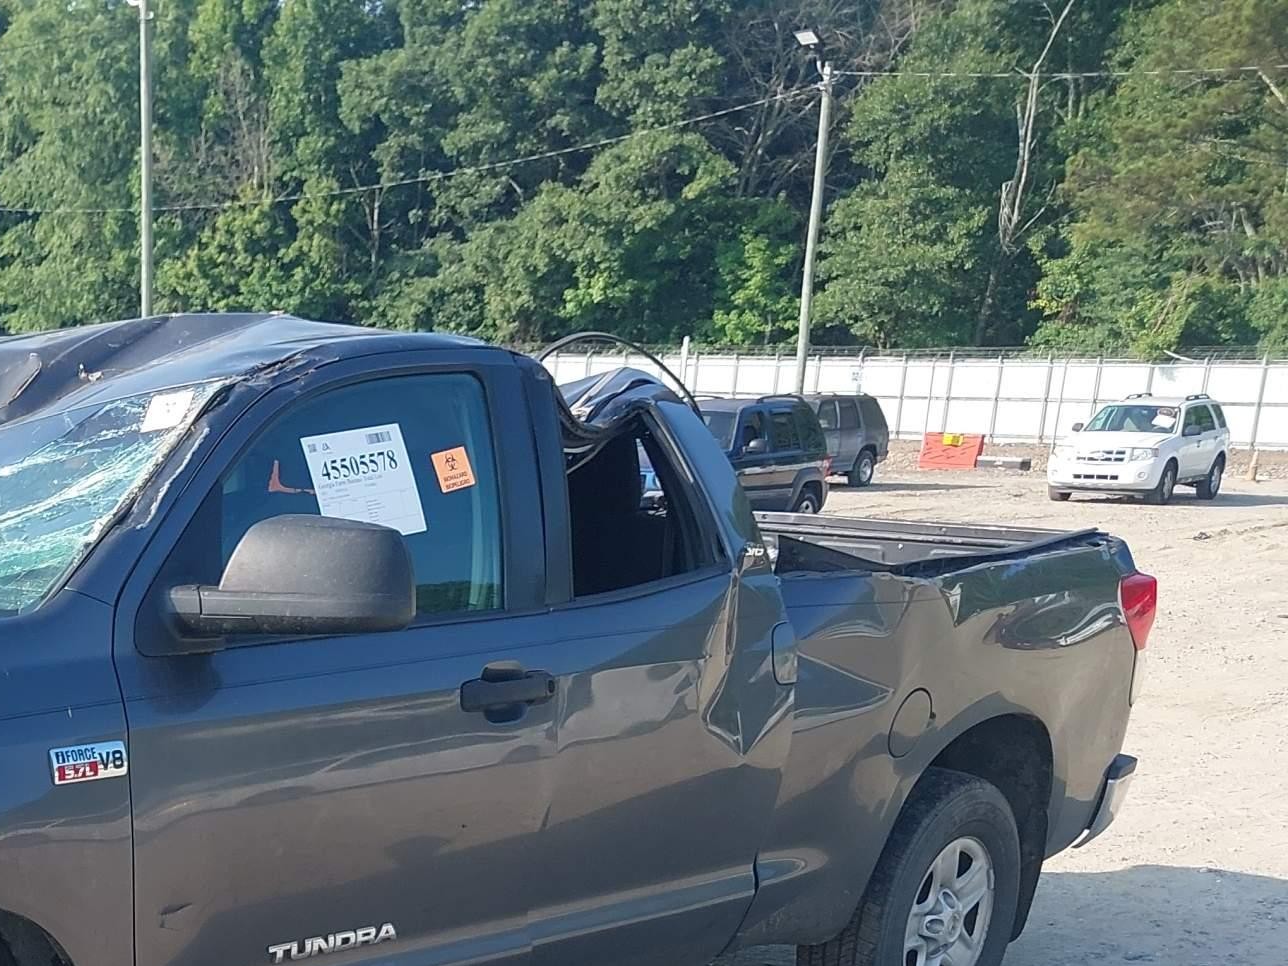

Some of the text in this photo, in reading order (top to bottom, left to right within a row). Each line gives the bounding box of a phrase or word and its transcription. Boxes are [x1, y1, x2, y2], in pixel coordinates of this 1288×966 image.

[321, 449, 398, 481] 45505578
[64, 764, 95, 779] 5.7L
[98, 749, 124, 770] V8
[268, 922, 397, 964] TUNDRA
